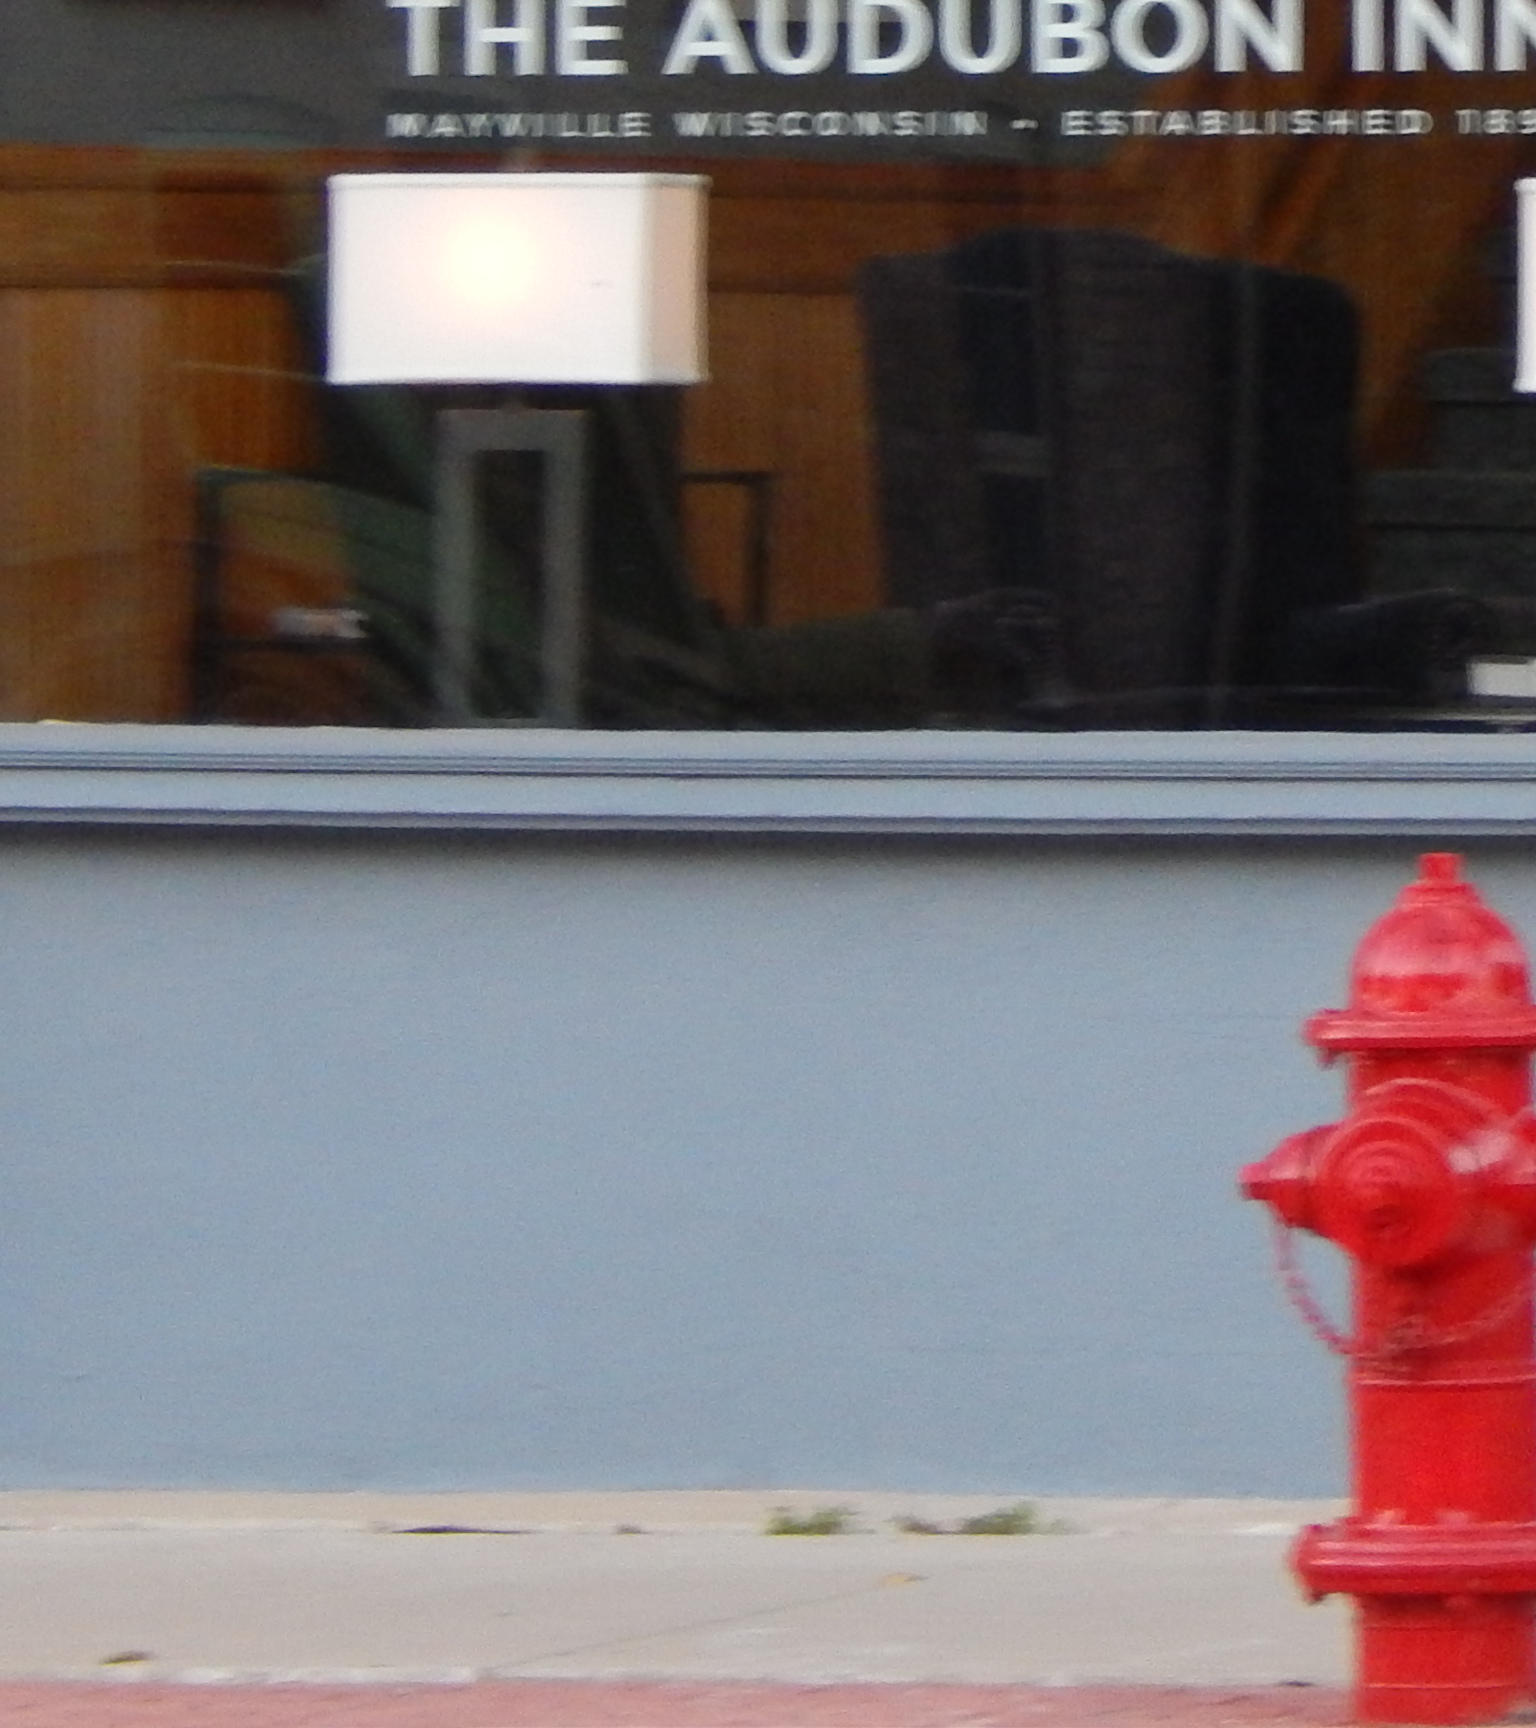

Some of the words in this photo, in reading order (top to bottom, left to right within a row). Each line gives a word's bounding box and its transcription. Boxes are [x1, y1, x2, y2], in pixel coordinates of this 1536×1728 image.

[386, 110, 652, 139] MAYVILLE
[674, 110, 989, 138] WISCONSIN
[1060, 109, 1434, 137] ESTABLISHED
